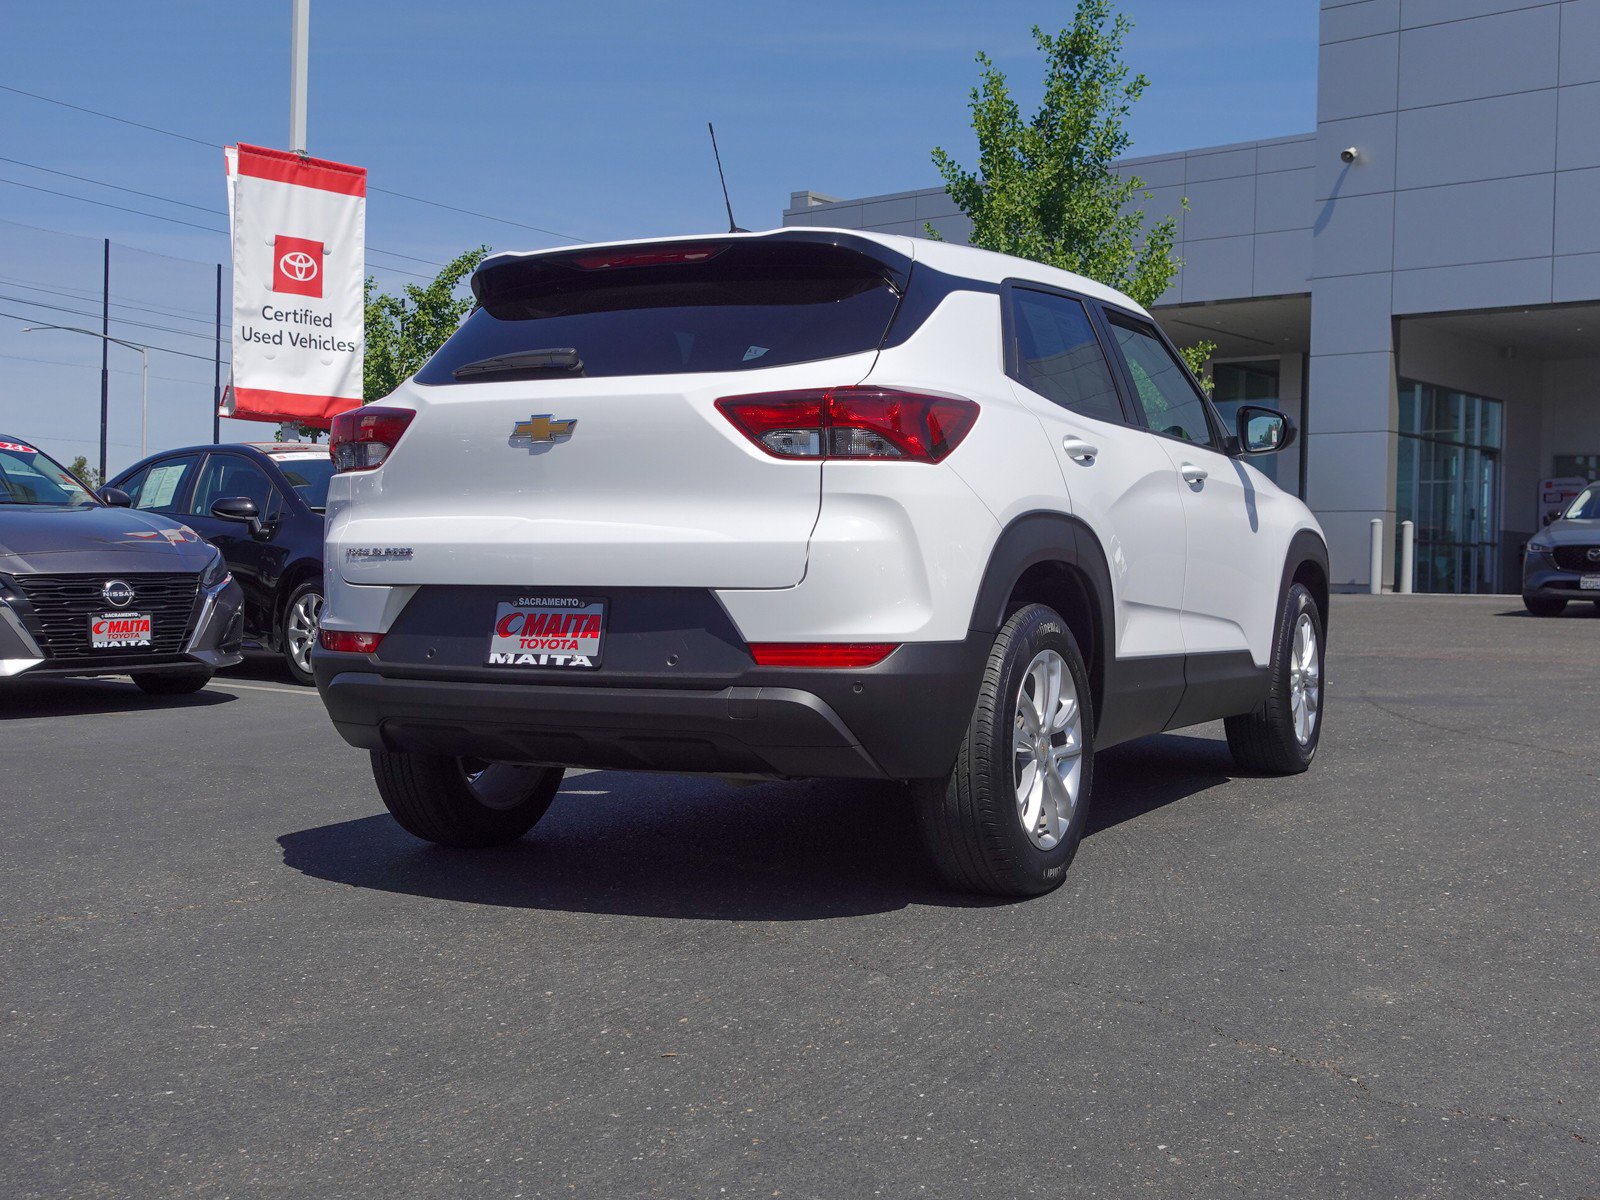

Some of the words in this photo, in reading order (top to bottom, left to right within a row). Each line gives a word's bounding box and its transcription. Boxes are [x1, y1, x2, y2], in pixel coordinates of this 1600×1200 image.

[262, 305, 333, 328] Certified
[241, 325, 283, 346] Used
[288, 331, 355, 353] Vehicles
[518, 597, 579, 607] SACRAMENTO
[107, 632, 141, 640] TOYOTA
[93, 639, 151, 648] MAITA
[519, 638, 579, 651] TOYOTA
[488, 652, 593, 667] MAITA
